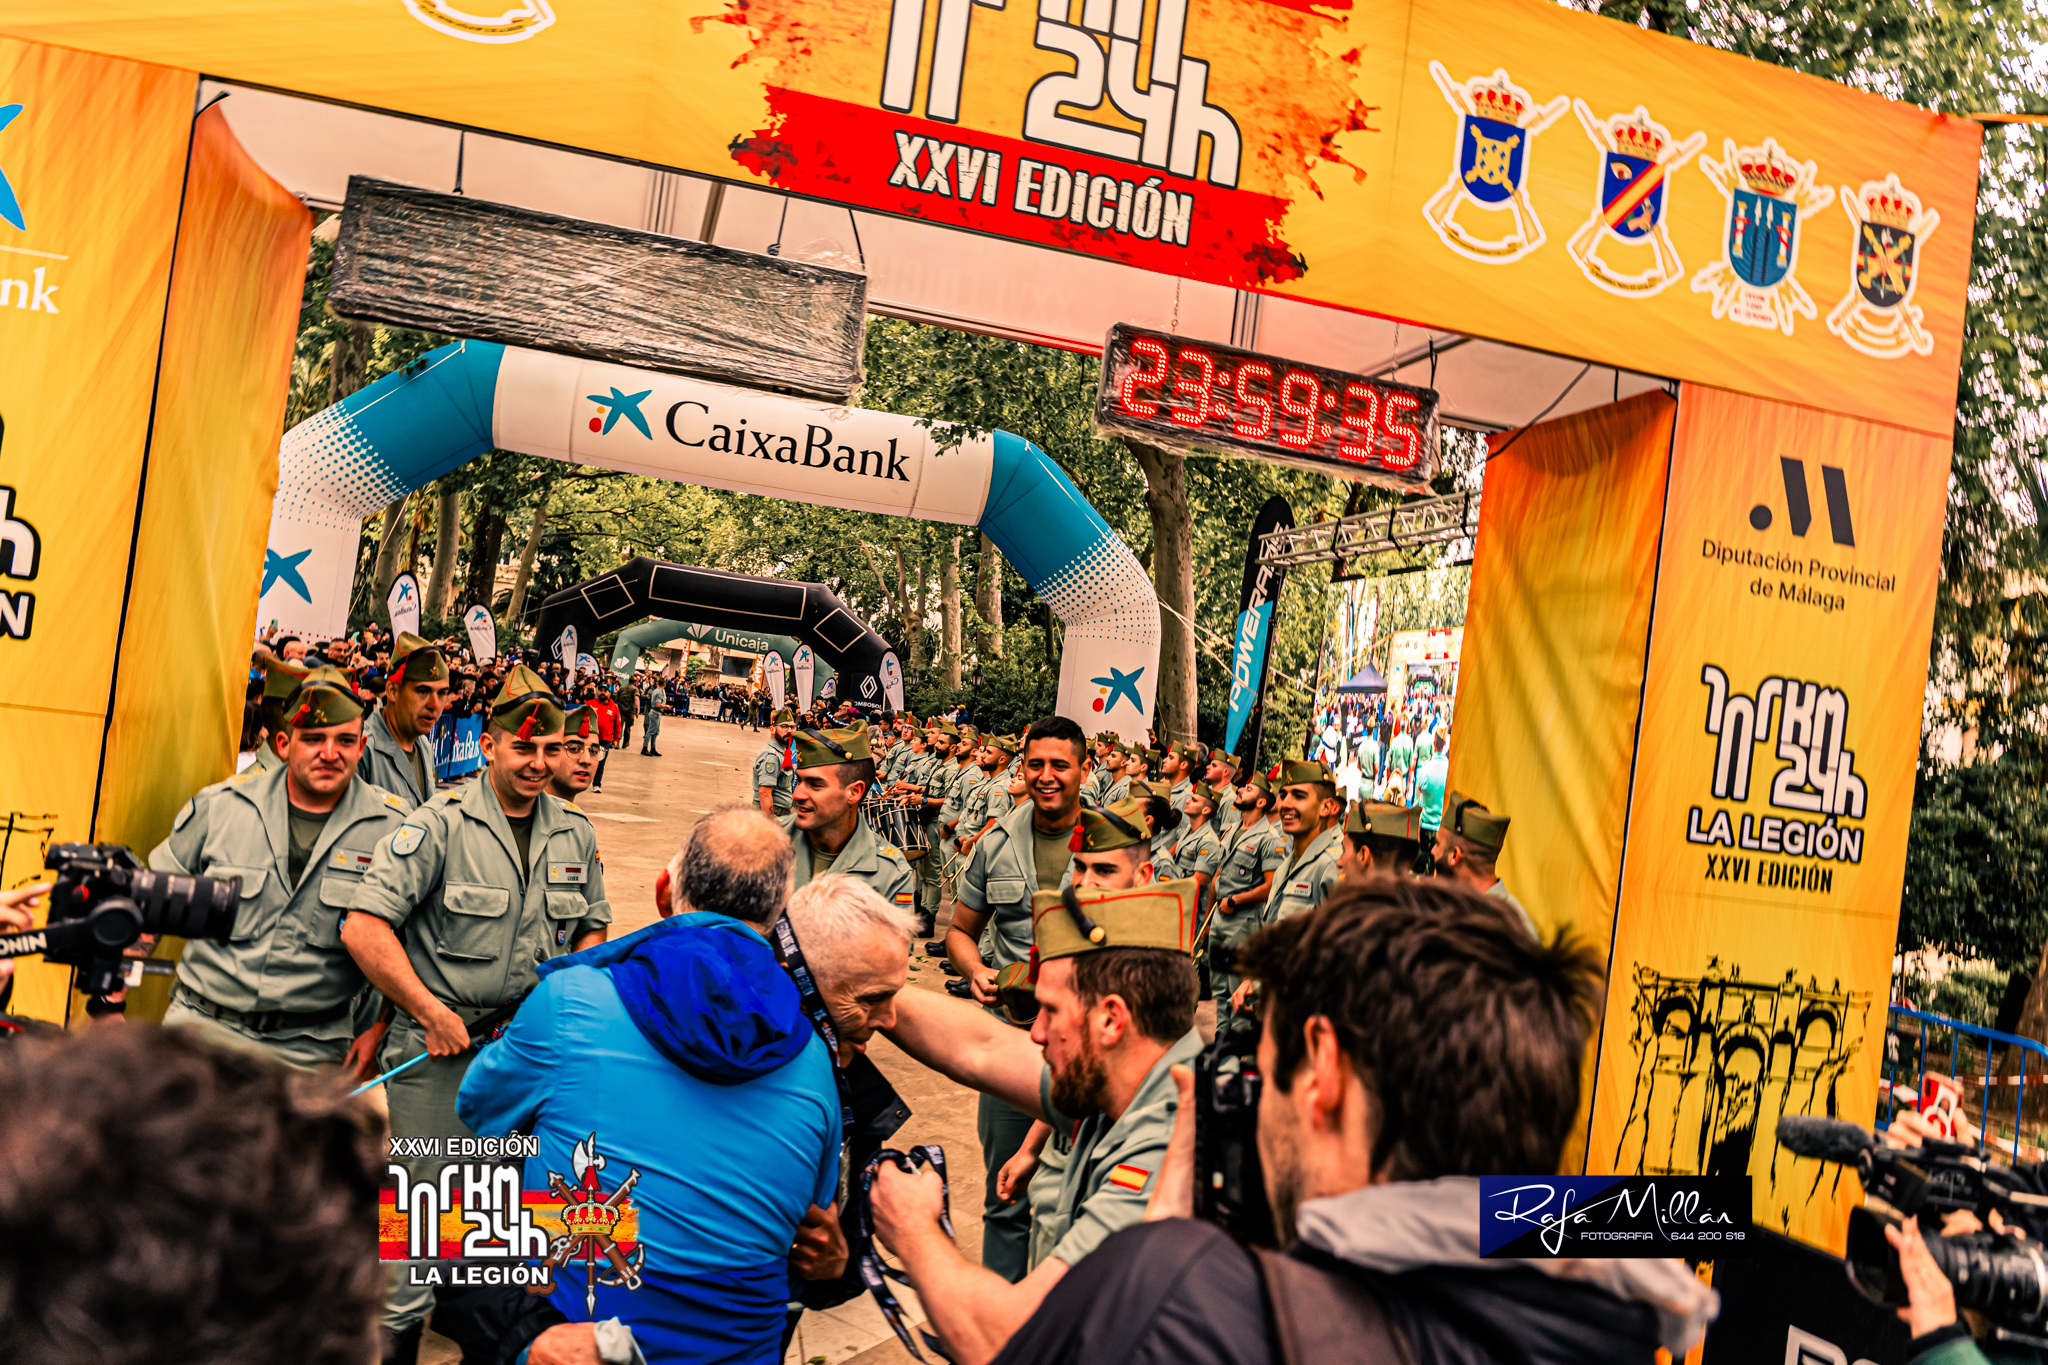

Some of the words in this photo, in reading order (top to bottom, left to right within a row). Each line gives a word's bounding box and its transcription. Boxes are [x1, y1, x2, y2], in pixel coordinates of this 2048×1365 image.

[888, 130, 1002, 206] XXVI
[1013, 156, 1194, 247] EDICIÓN
[1122, 340, 1419, 469] 23:59:35
[665, 400, 911, 483] CaixaBank
[1702, 539, 1803, 575] Diputación
[1809, 558, 1896, 593] Provincial
[1749, 577, 1774, 598] de
[1778, 582, 1846, 612] Málaga
[715, 629, 769, 651] Unicaja
[1770, 741, 1868, 819] 24h
[1687, 806, 1735, 847] LA
[1739, 813, 1864, 864] LEGIÓN
[1705, 853, 1752, 884] XXVI
[1757, 859, 1834, 895] EDICIÓN
